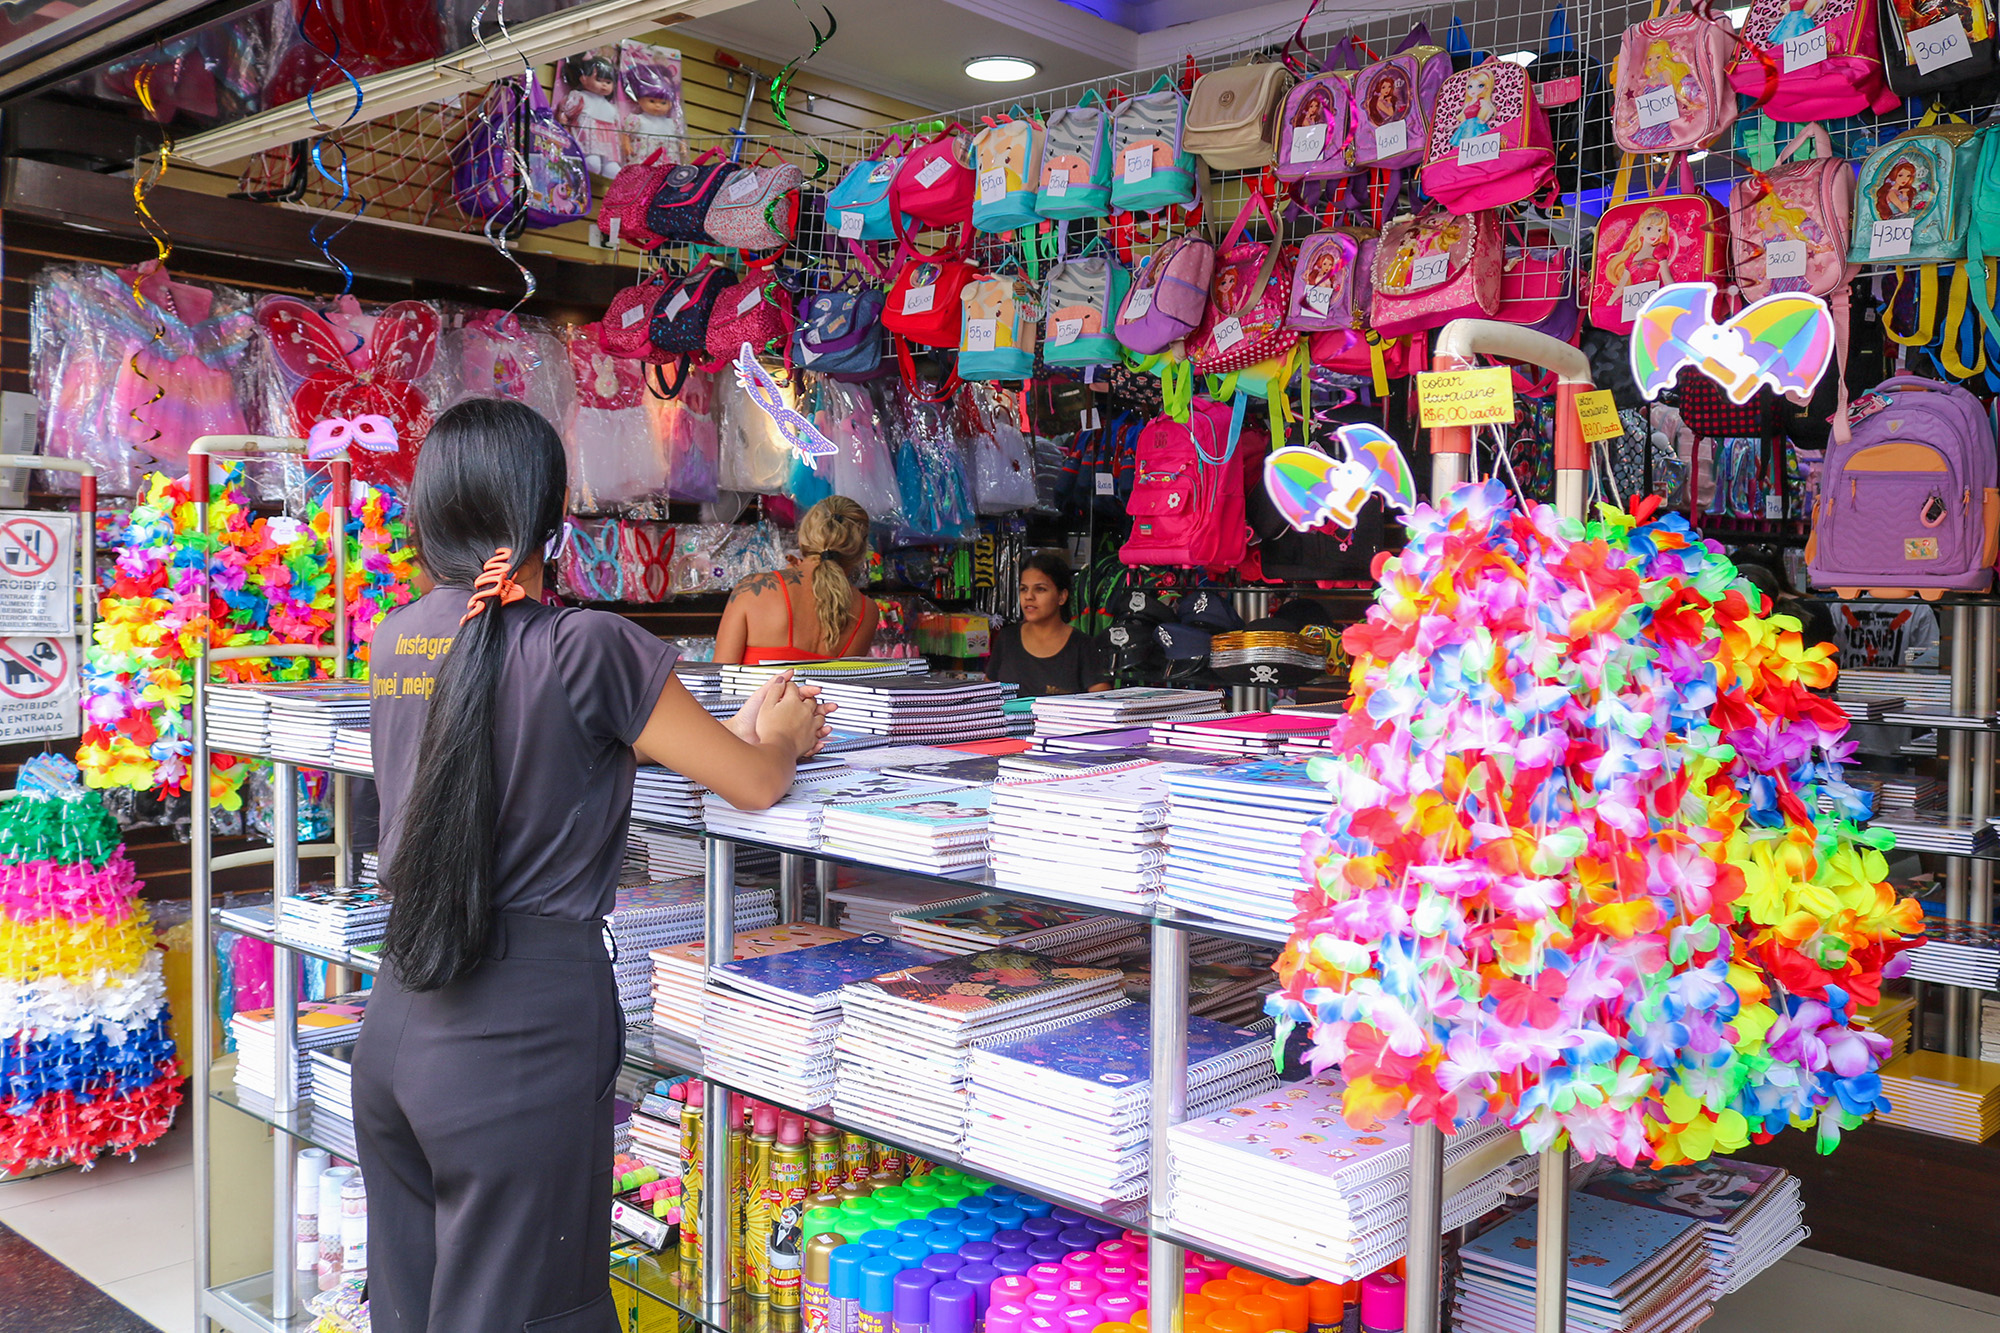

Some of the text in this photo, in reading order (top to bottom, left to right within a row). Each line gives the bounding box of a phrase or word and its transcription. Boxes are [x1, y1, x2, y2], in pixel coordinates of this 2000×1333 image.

[1423, 403, 1508, 424] R$6,00 cada
[394, 633, 456, 661] Instagra
[7, 712, 63, 724] ENTRADA
[0, 723, 64, 737] DE ANIMAIS
